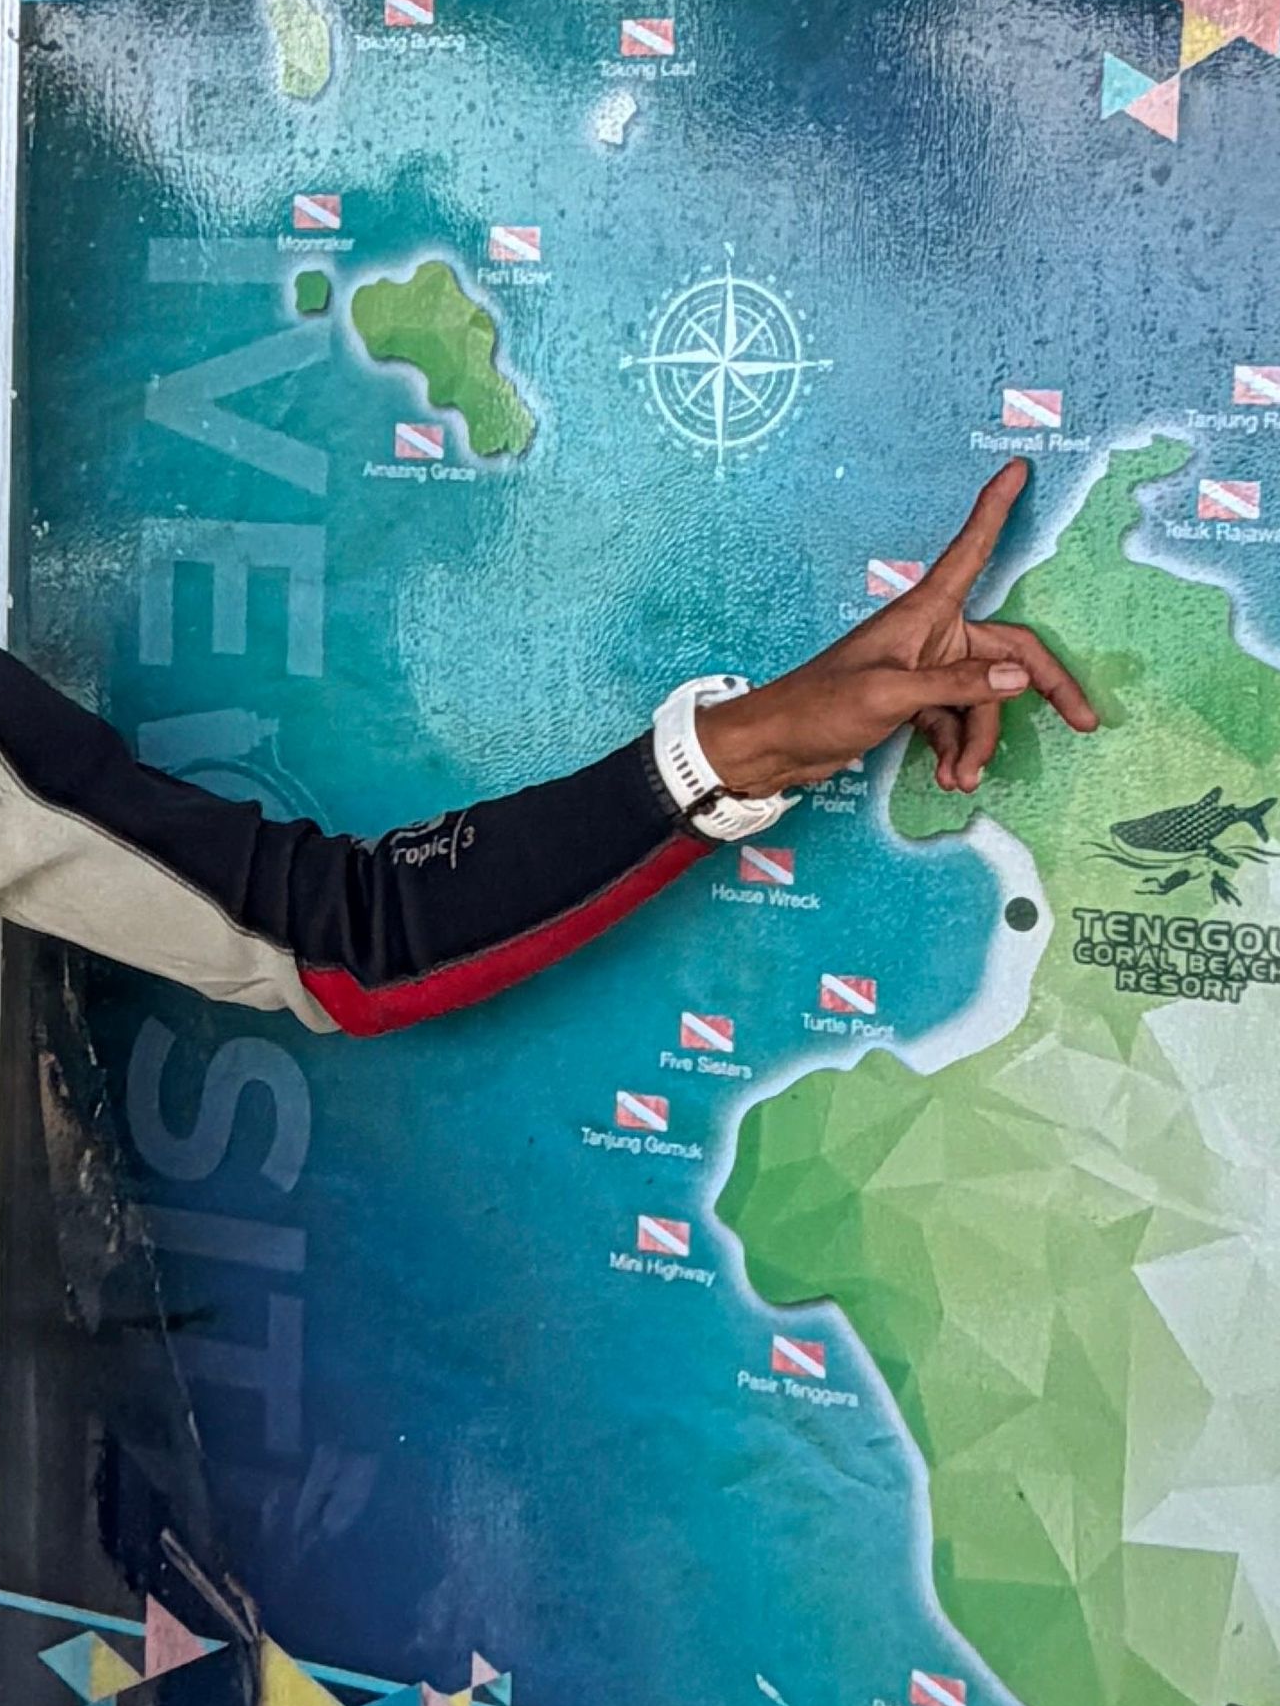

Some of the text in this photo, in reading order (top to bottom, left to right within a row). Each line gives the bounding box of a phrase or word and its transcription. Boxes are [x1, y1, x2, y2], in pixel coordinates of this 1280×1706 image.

[477, 267, 511, 285] Fish
[1184, 409, 1259, 435] Tanjung
[363, 461, 477, 483] Amazing Grace
[839, 776, 869, 798] Set
[811, 794, 856, 816] Point
[390, 833, 451, 868] ropic
[461, 824, 476, 849] 3
[712, 882, 821, 911] House Wreck
[1074, 942, 1178, 972] CORAL
[1116, 969, 1248, 1003] RESORT
[800, 1011, 895, 1039] Turtle Point
[659, 1050, 753, 1081] Five Sisters
[581, 1126, 703, 1161] Tanjung Gemuk
[609, 1251, 716, 1288] Mini Highway
[736, 1369, 859, 1409] Pasir Tenggara
